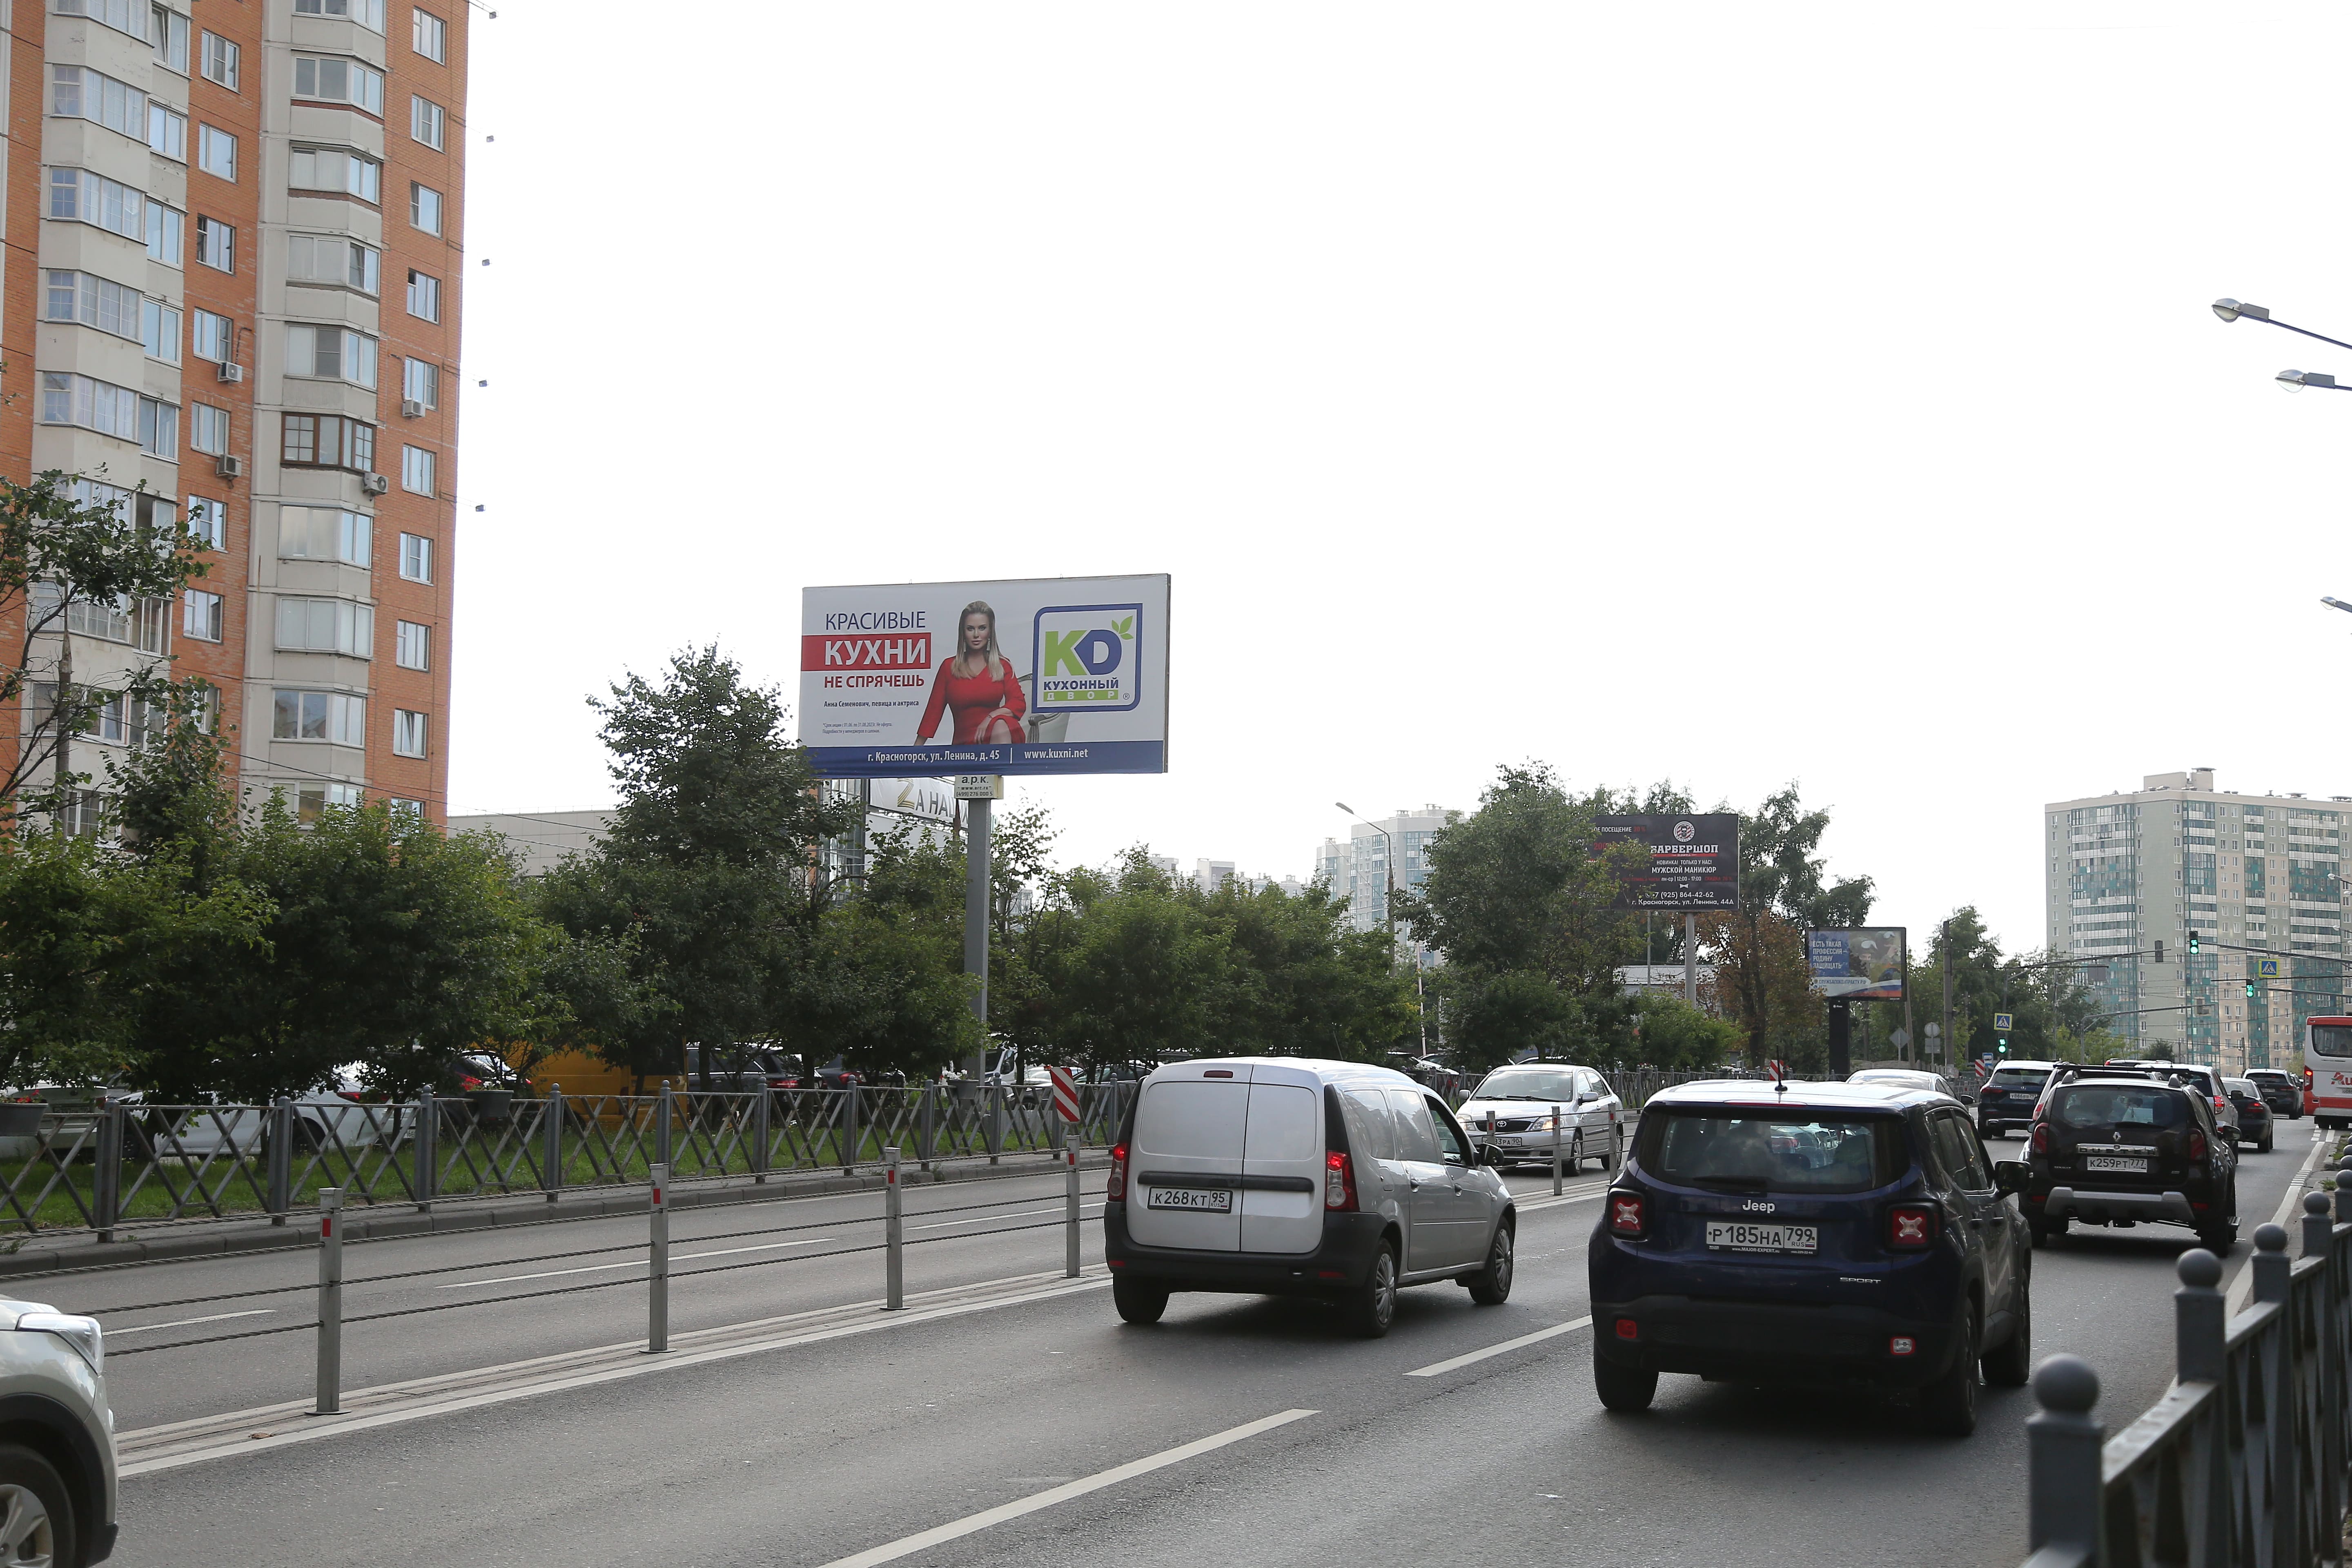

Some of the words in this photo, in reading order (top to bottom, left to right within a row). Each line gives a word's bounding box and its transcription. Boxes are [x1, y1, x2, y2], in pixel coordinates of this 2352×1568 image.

[826, 611, 926, 630] КРАСИВЫЕ
[824, 639, 926, 665] КУХНИ
[824, 676, 842, 688] НЕ
[846, 675, 924, 688] СПРЯЧЕШЬ
[1044, 677, 1119, 690] КУХОННЫЙ
[1047, 691, 1114, 700] ДВОР
[875, 752, 928, 763] Красногорск,
[930, 753, 942, 762] ул.
[944, 751, 978, 762] Ленина,
[979, 752, 988, 761] д.
[989, 750, 1000, 760] 45
[1024, 748, 1088, 759] www.kuxni.net
[1650, 844, 1718, 853] БАРБЕРШОП
[2090, 1158, 2128, 1168] К259РТ
[1155, 1191, 1207, 1206] К268КТ
[1212, 1192, 1225, 1203] 95
[1742, 1200, 1775, 1213] Jeep
[1713, 1225, 1782, 1245] Р185НА
[1786, 1227, 1813, 1242] 799
